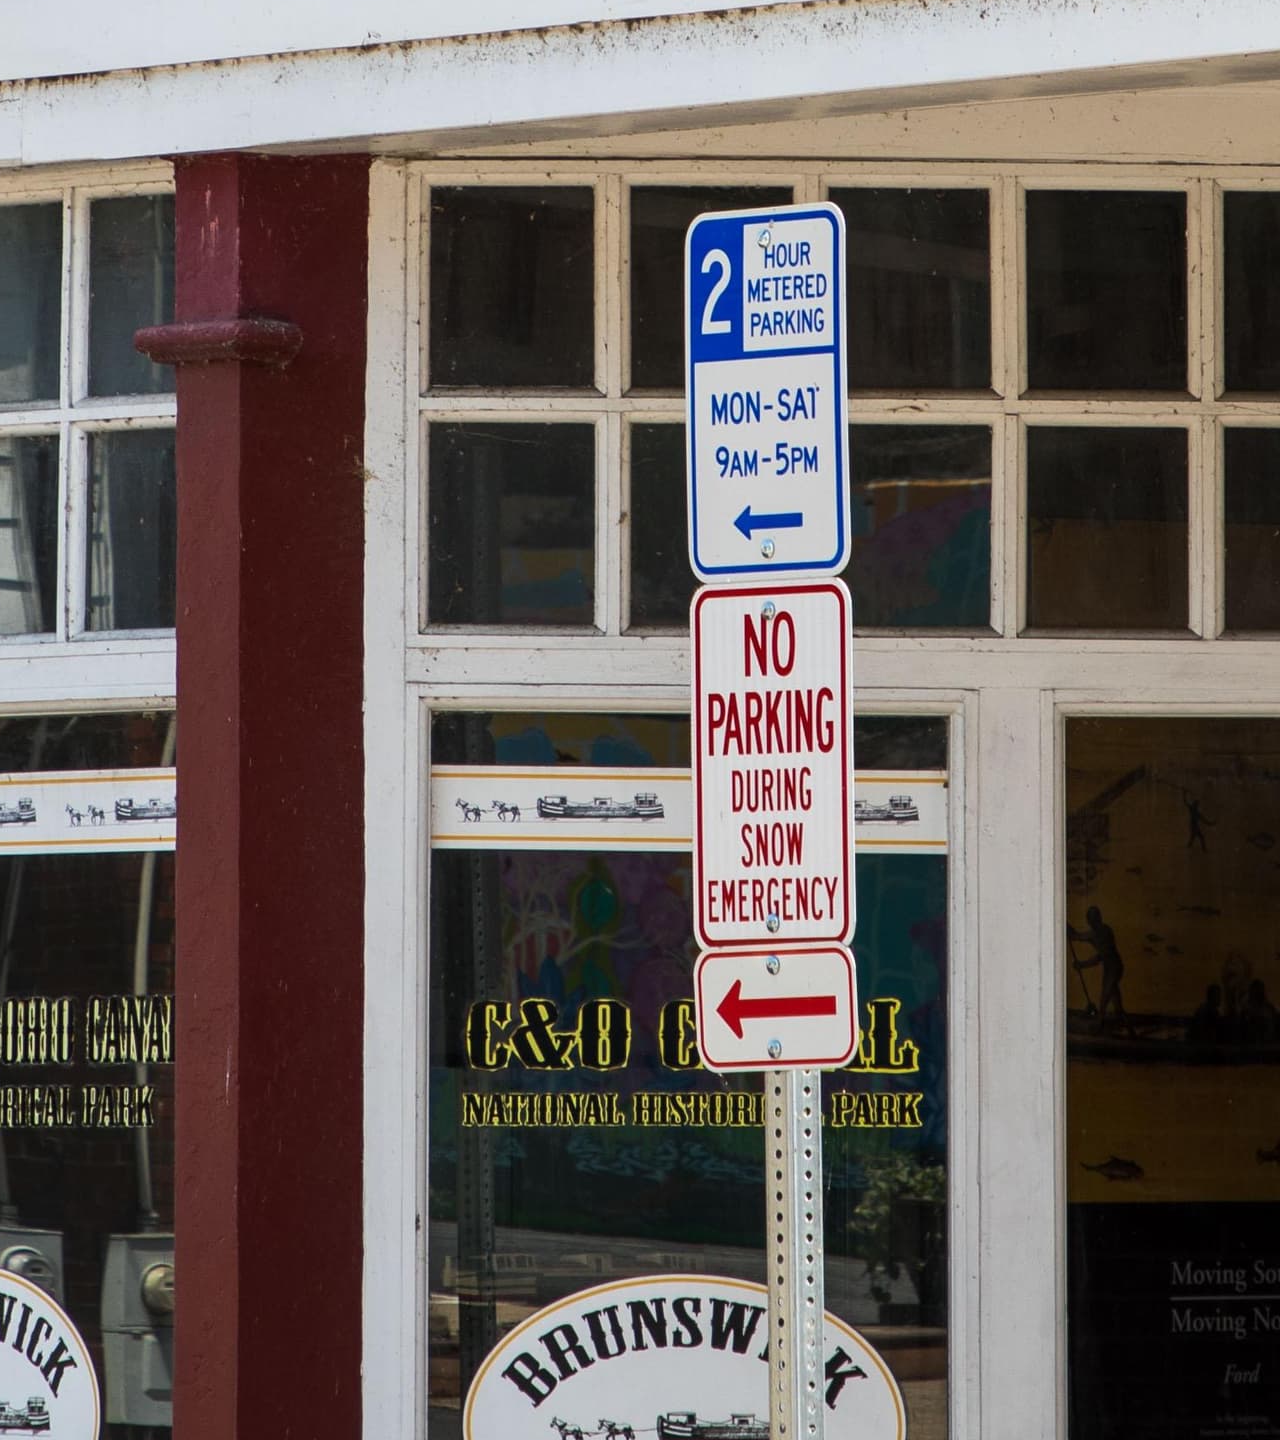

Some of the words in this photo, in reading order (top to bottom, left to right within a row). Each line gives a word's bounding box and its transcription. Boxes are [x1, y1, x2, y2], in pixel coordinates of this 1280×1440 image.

[764, 241, 811, 270] HOUR
[700, 248, 732, 335] 2
[747, 273, 827, 304] METERED
[750, 308, 825, 337] PARKING
[744, 609, 796, 677] NO
[708, 687, 834, 757] PARKING
[731, 766, 812, 814] DURING
[741, 822, 804, 868] SNOW
[708, 877, 838, 924] EMERGENCY
[0, 997, 75, 1065] OHIO
[466, 998, 631, 1072] C&O
[82, 1085, 156, 1129] PARK
[462, 1092, 625, 1127] NATIONAL
[632, 1091, 824, 1127] HISTORI
[831, 1091, 924, 1128] PARK
[1170, 1260, 1248, 1293] Moving
[1170, 1306, 1248, 1341] Moving
[501, 1296, 868, 1410] BRUNSWK
[1223, 1361, 1262, 1385] Ford
